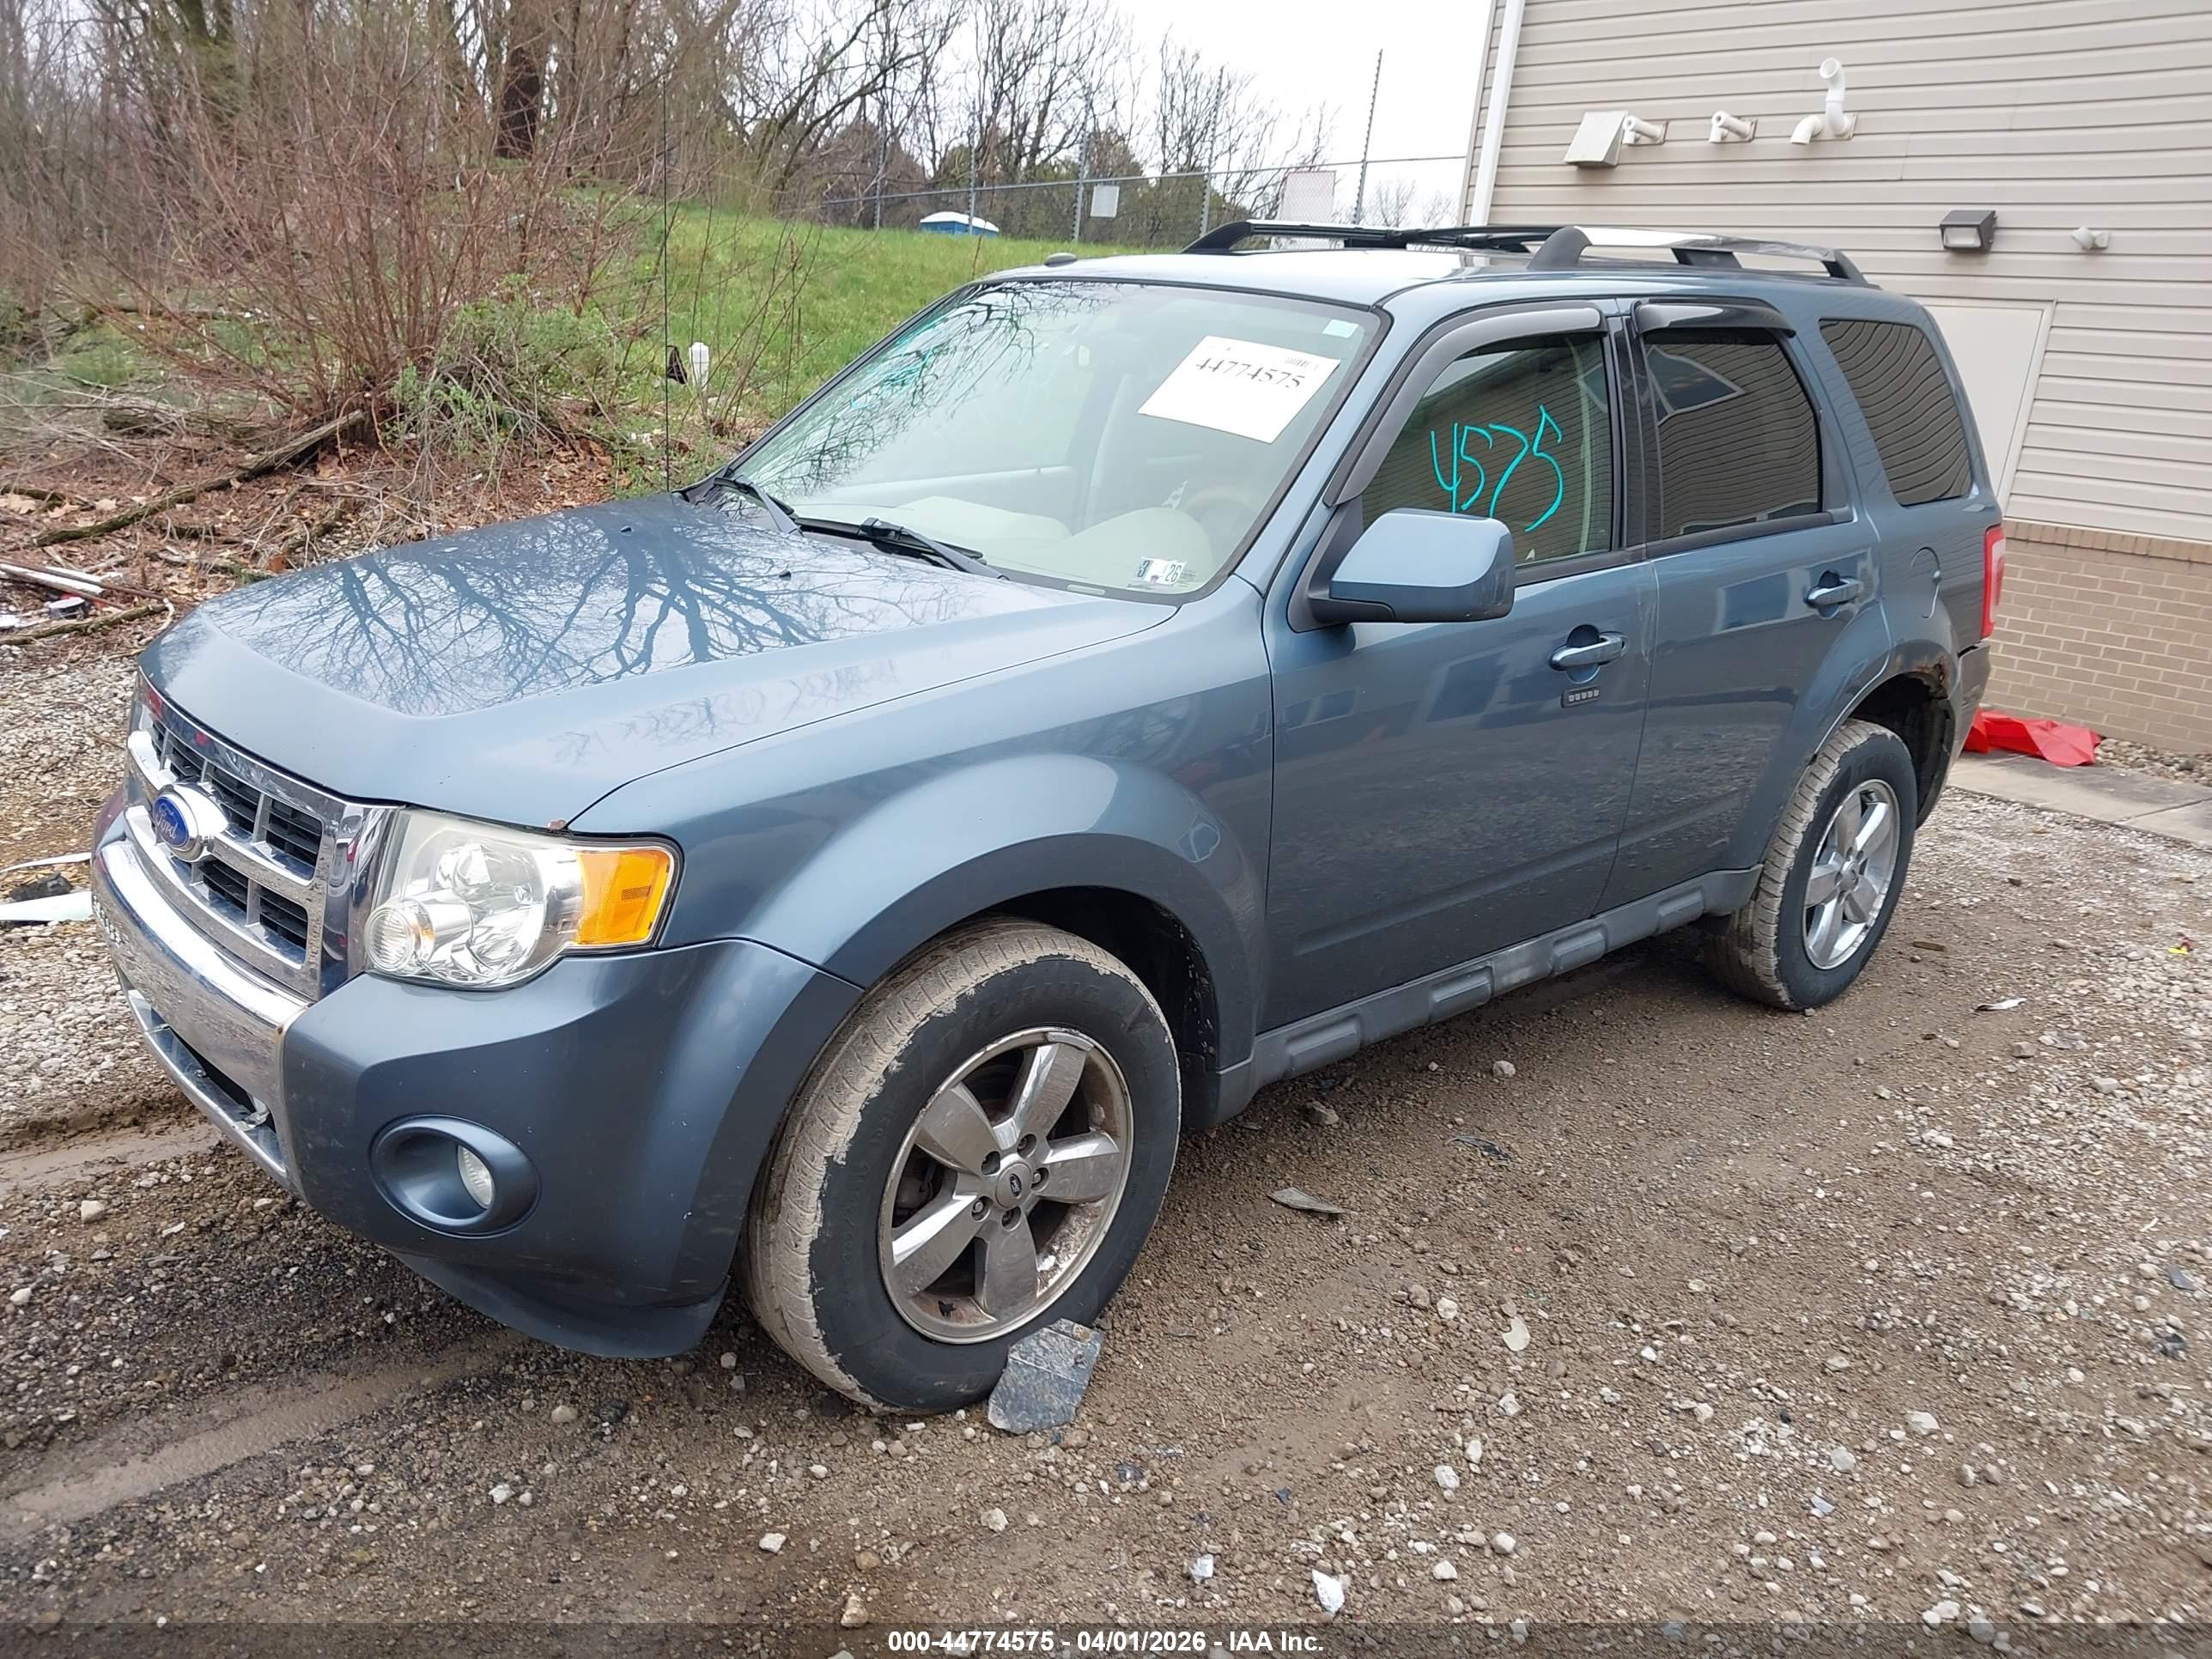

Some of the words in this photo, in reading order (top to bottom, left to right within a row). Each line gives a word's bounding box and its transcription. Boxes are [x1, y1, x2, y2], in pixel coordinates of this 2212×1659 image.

[1195, 356, 1305, 389] 44774575
[1430, 404, 1564, 532] 4575
[1164, 563, 1182, 582] 26
[156, 803, 179, 839] Ford
